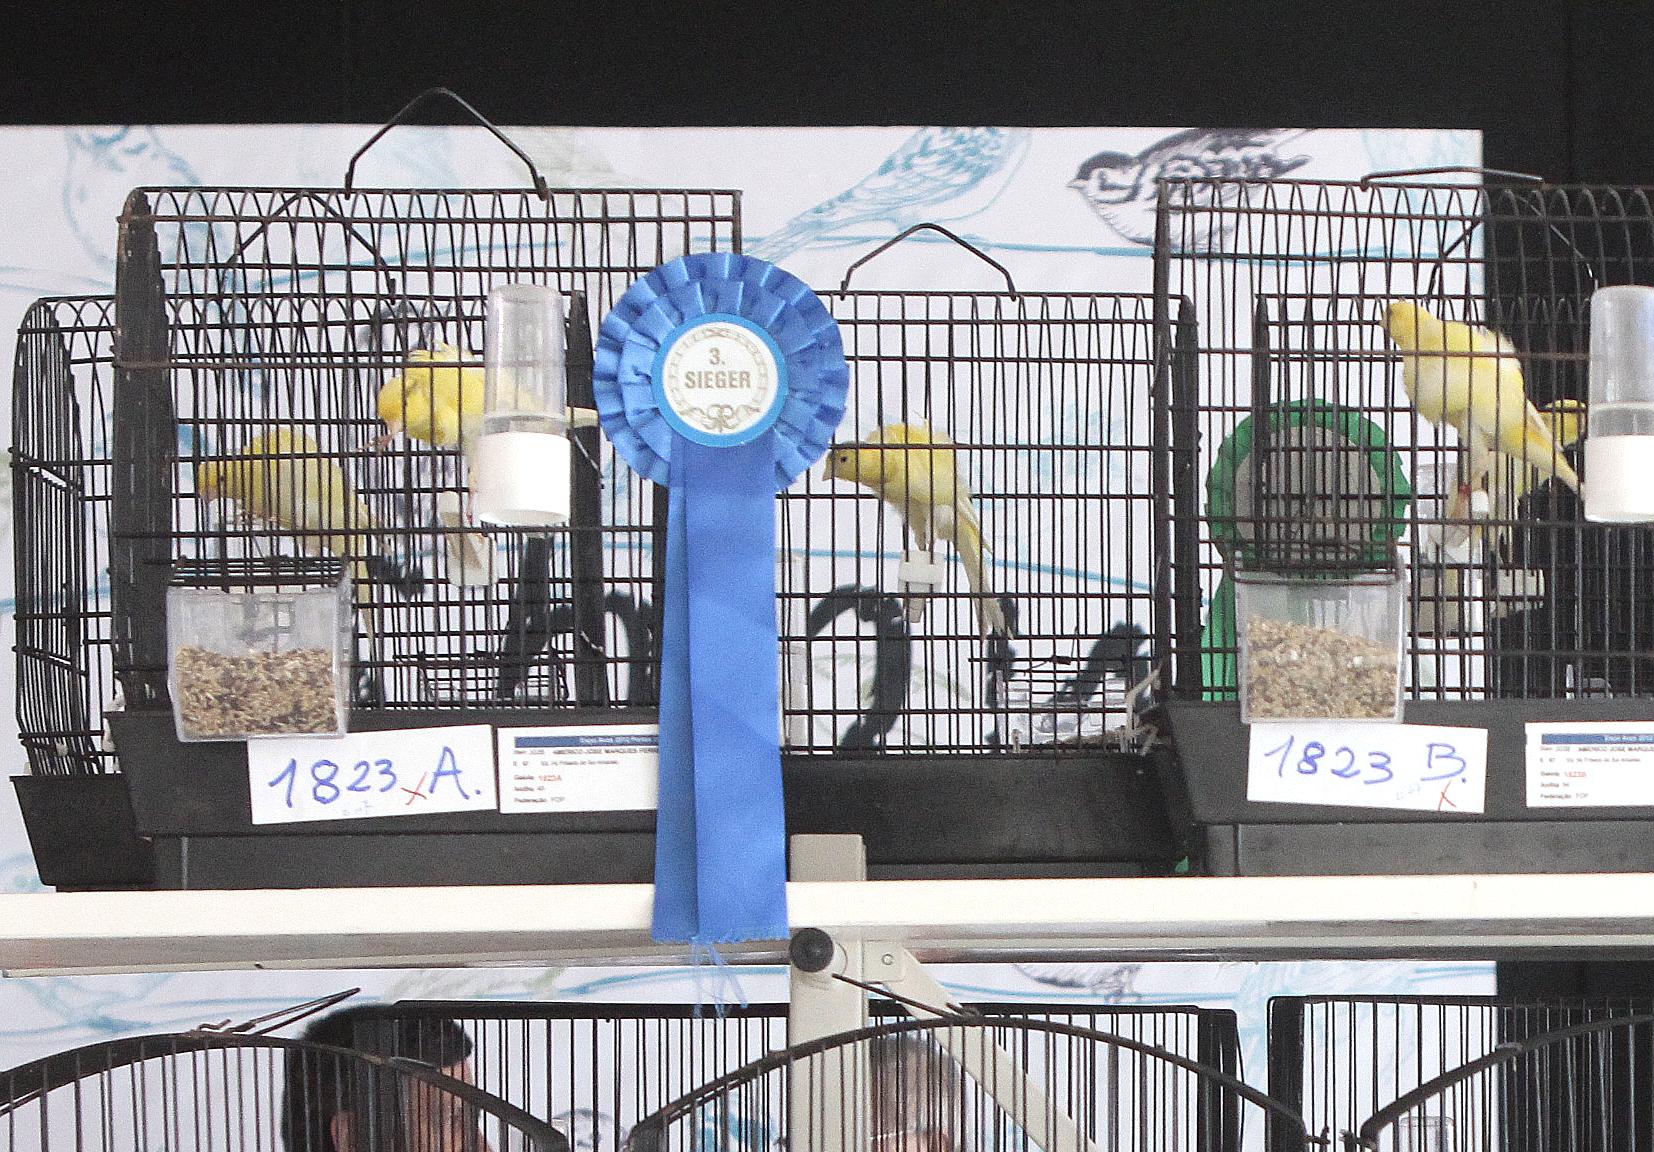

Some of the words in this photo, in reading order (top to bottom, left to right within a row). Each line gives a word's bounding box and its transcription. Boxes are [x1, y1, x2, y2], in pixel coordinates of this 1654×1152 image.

[707, 346, 726, 366] 3.
[684, 370, 752, 389] SIEGER
[1264, 735, 1393, 784] 1823
[268, 758, 397, 808] 1823
